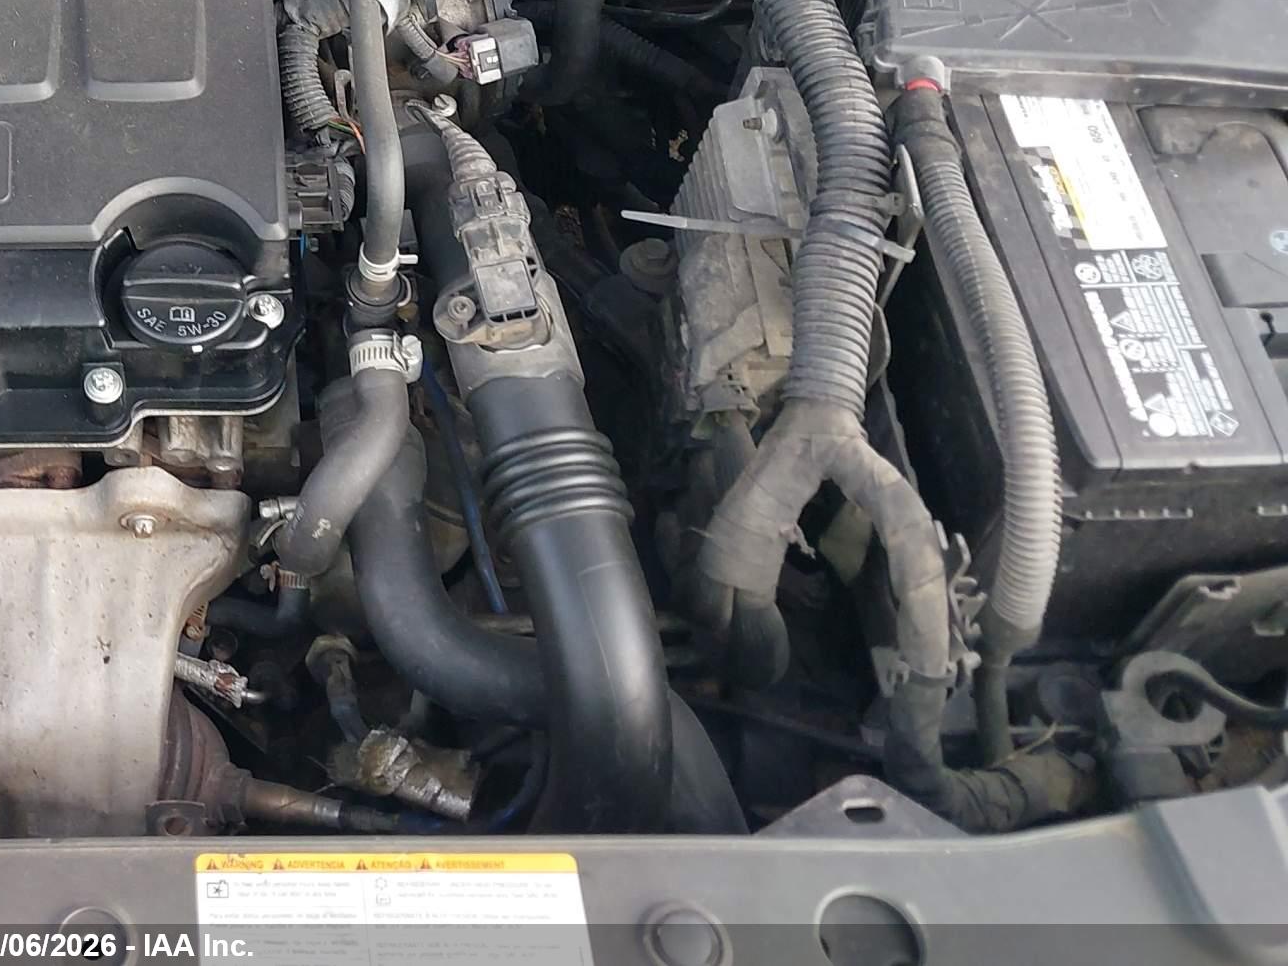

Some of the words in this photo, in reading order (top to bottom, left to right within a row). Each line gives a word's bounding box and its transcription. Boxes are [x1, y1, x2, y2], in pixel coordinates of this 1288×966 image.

[136, 307, 167, 333] SAE
[177, 310, 228, 337] 5W-30
[222, 859, 263, 870] WARNING
[288, 859, 345, 870] ADVERTENCIA
[436, 860, 505, 870] AVERTISSEMENT
